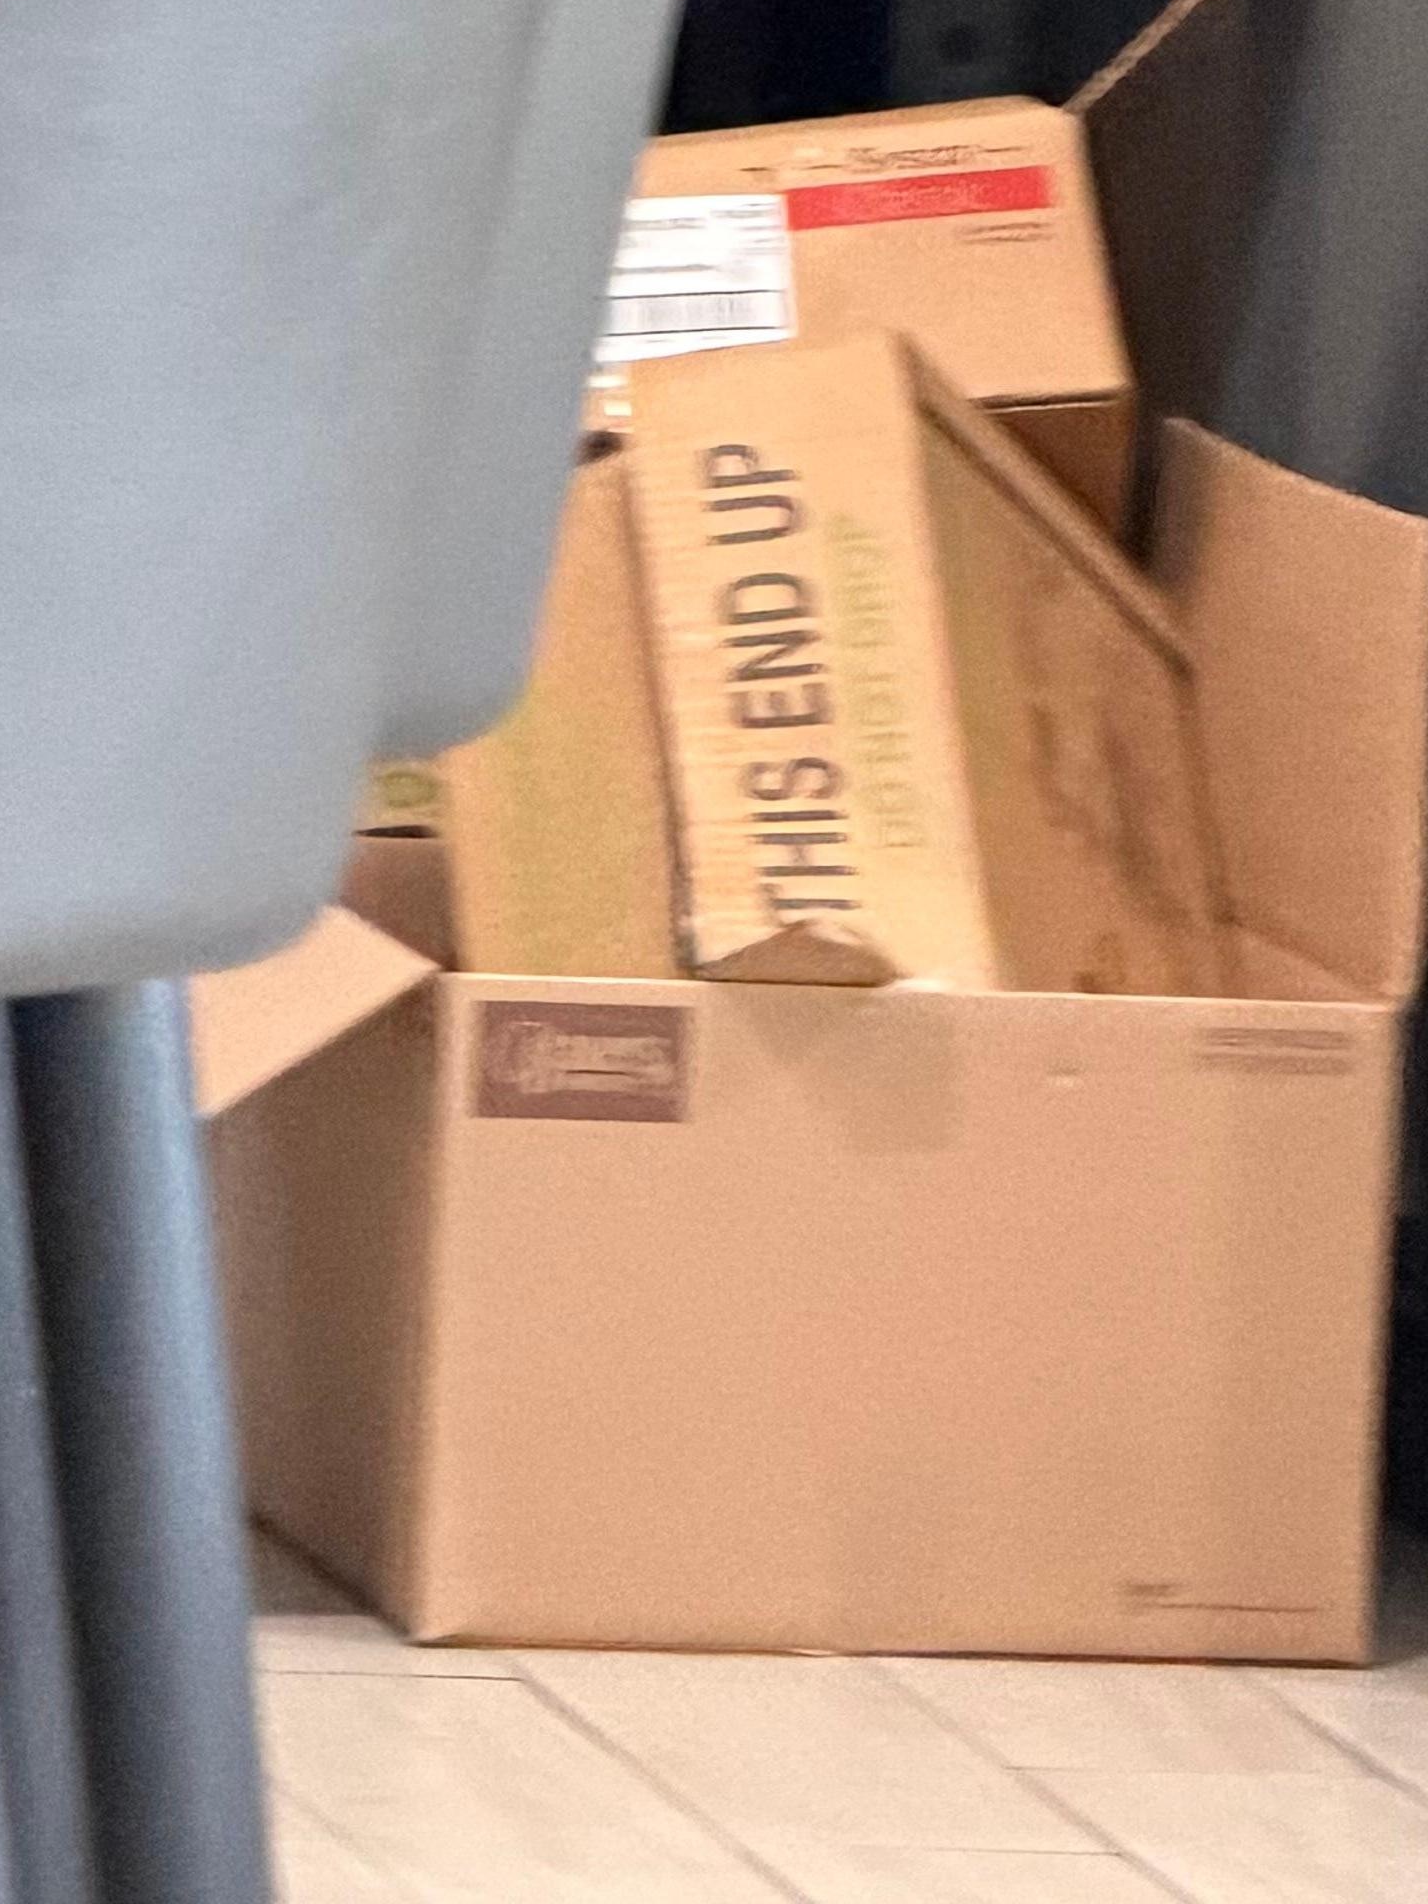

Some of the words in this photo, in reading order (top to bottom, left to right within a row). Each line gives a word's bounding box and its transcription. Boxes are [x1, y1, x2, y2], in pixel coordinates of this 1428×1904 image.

[696, 442, 810, 546] UP
[715, 570, 834, 729] END
[739, 756, 864, 928] THIS
